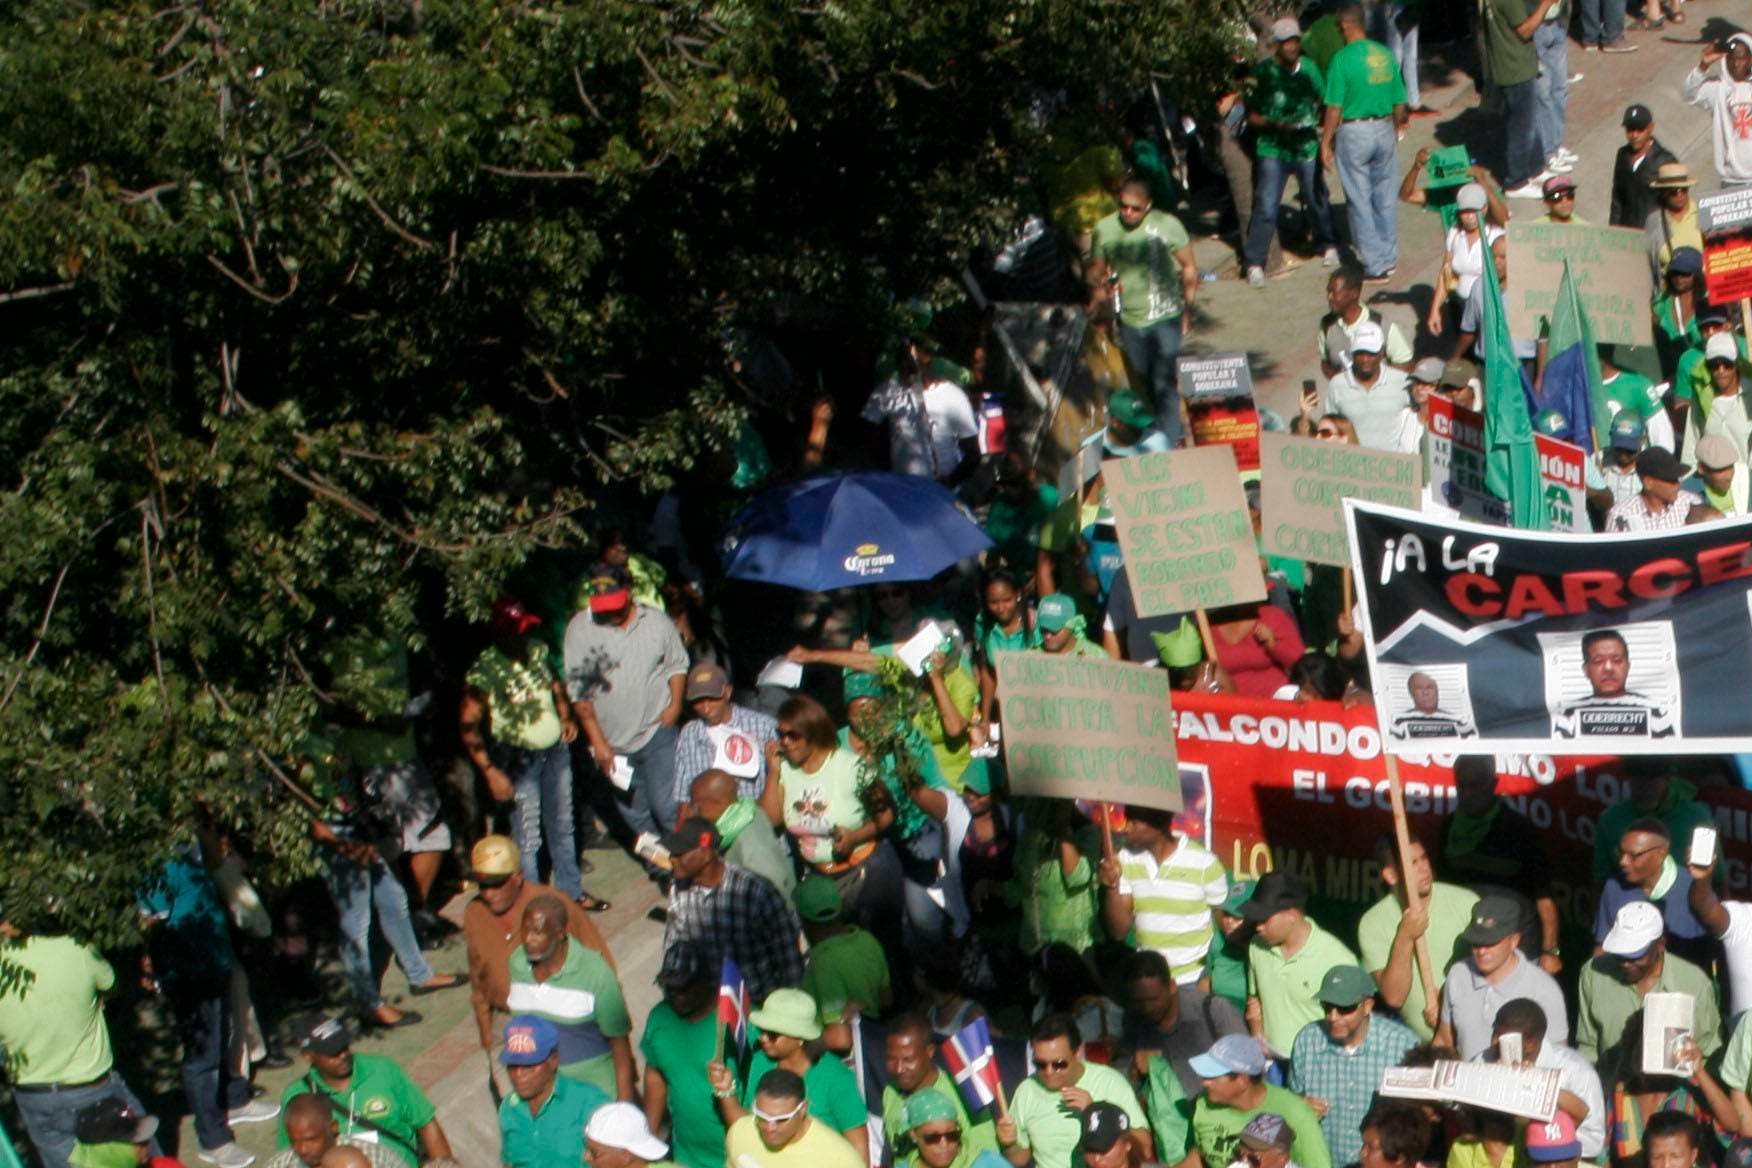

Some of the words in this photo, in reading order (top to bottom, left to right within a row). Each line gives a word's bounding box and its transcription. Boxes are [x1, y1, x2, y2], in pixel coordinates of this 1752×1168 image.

[1710, 200, 1748, 217] POPULAR
[1380, 533, 1426, 585] ¡A
[1441, 535, 1500, 576] LA
[1170, 710, 1381, 761] ALCONDO
[1581, 711, 1647, 725] ODEBRECHT
[1292, 769, 1336, 805] EL
